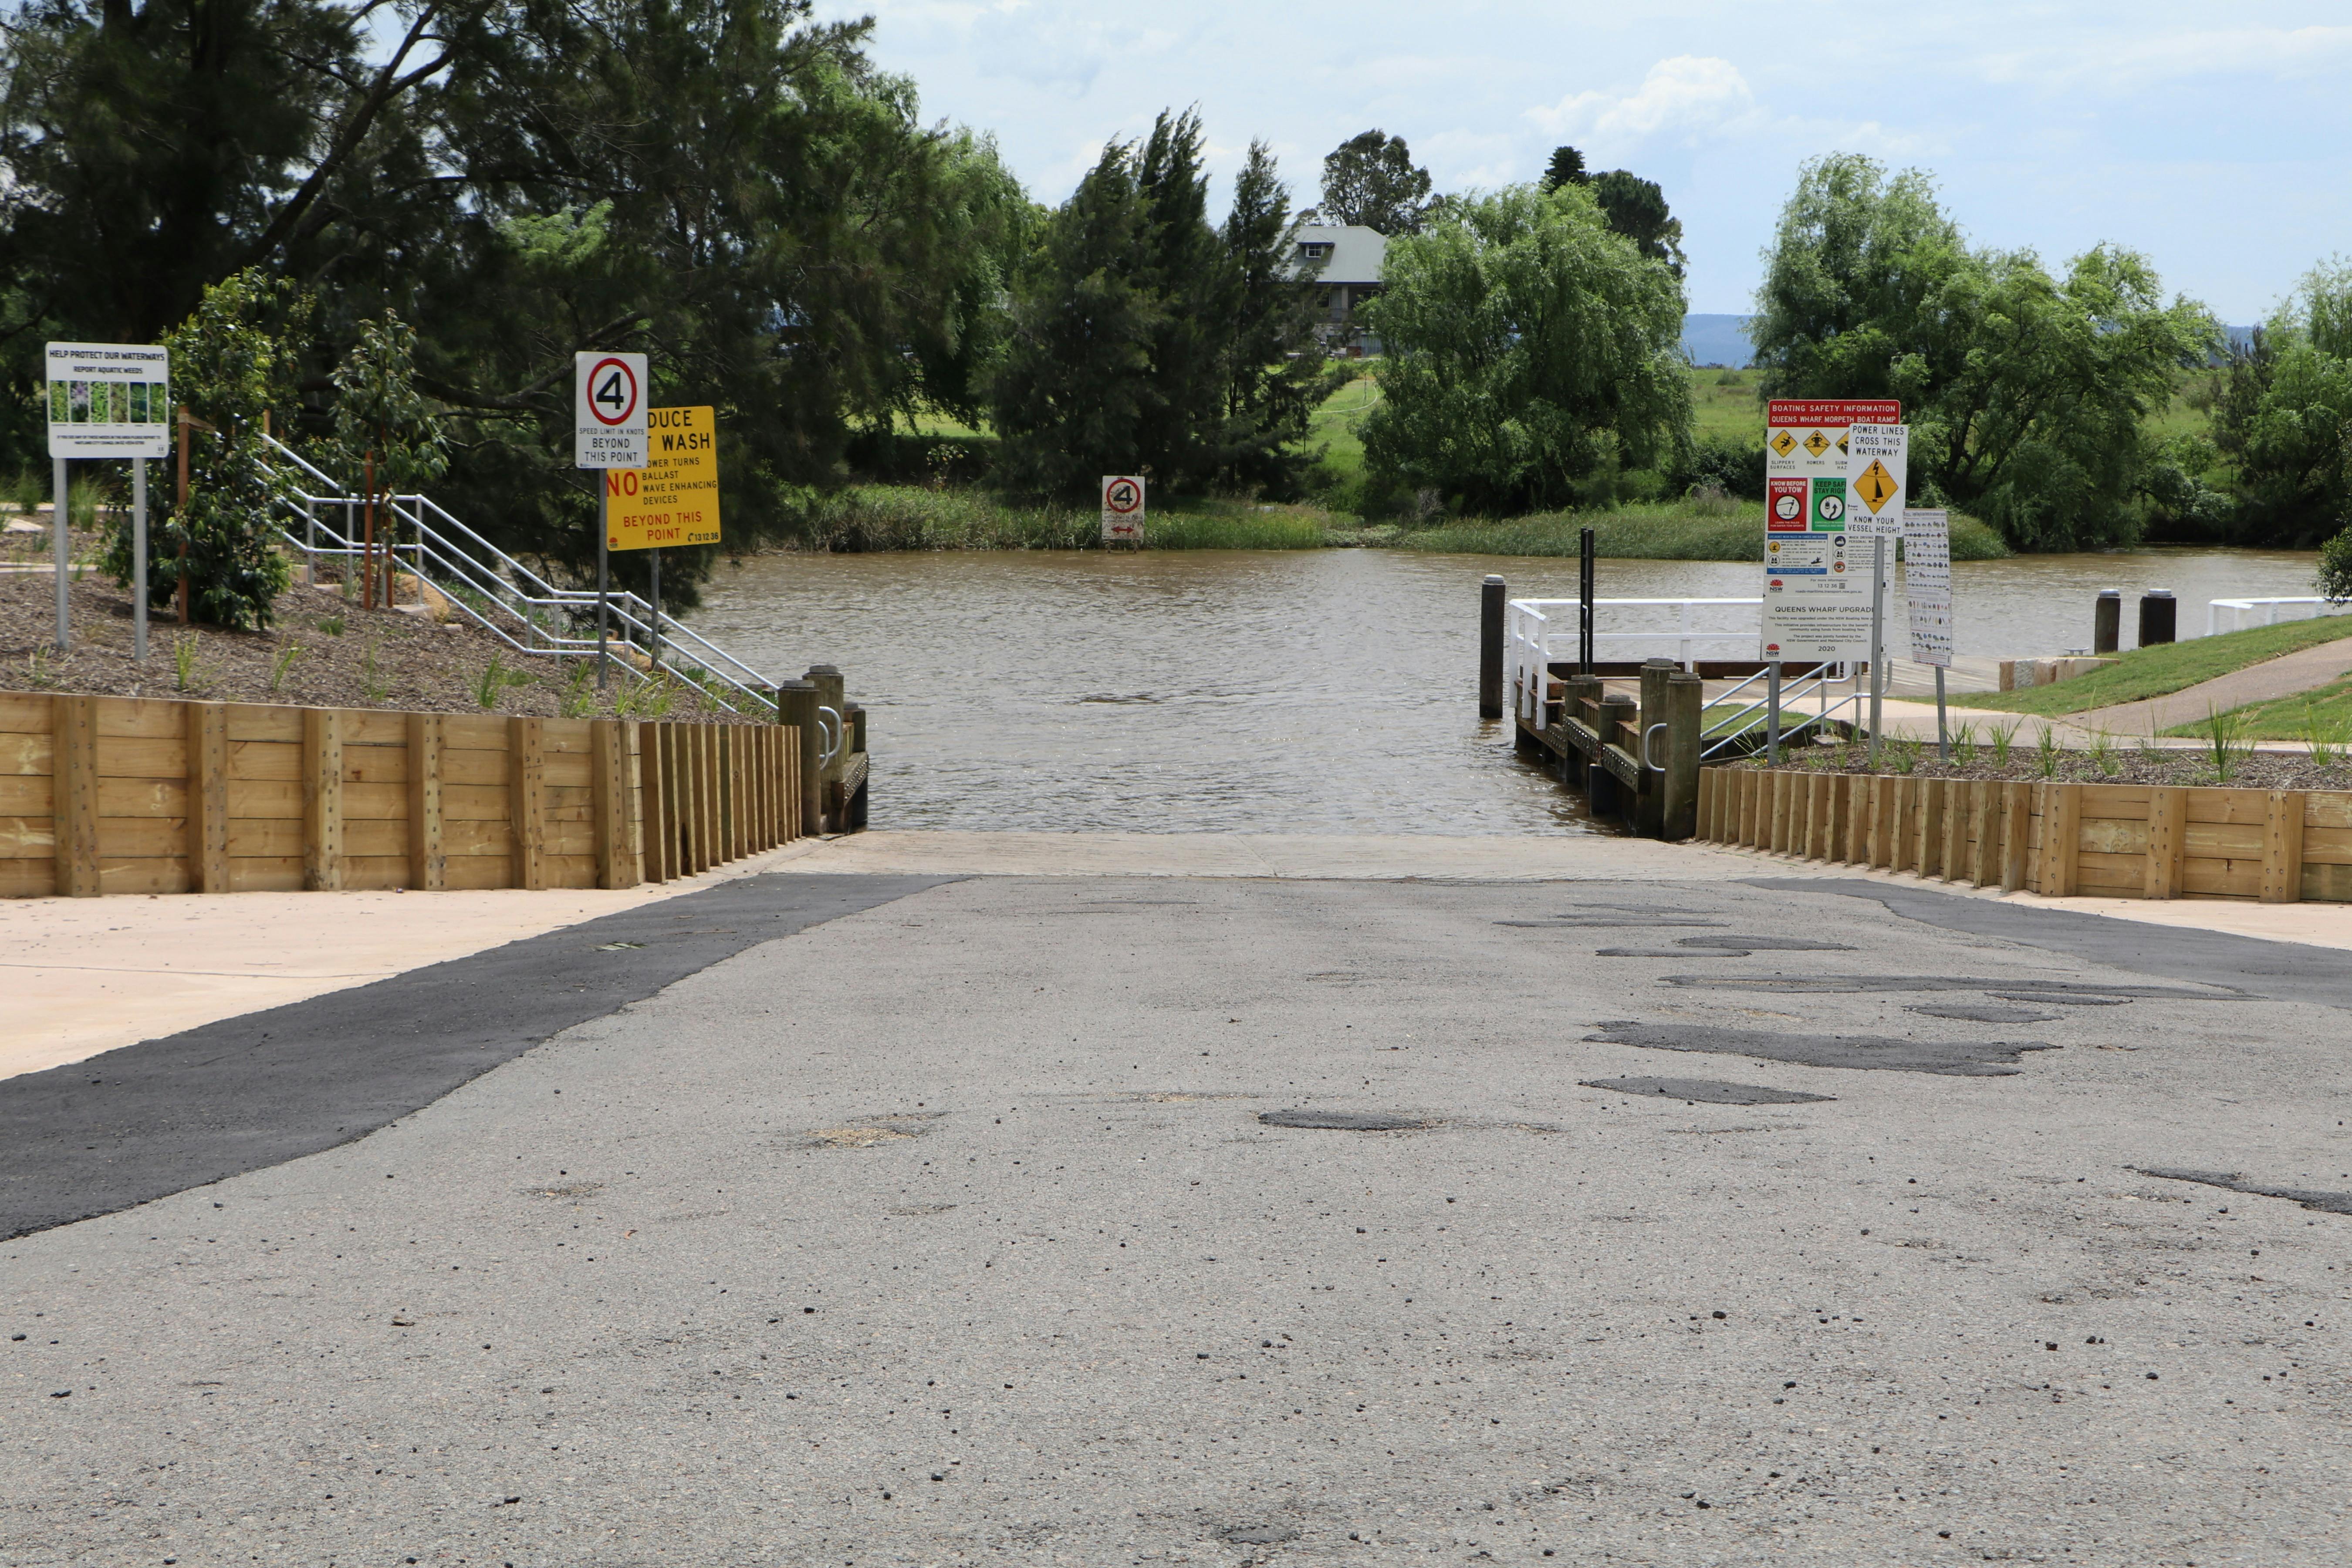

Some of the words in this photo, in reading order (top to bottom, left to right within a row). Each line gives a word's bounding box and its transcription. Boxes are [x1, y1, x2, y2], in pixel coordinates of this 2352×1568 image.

[70, 350, 103, 359] PROTECT
[121, 352, 165, 361] WATERWAYS
[596, 372, 624, 409] 4
[648, 410, 692, 429] DUCE
[1853, 426, 1878, 434] POWER
[1882, 427, 1904, 435] LINES
[592, 438, 630, 448] BEYOND
[662, 432, 710, 451] WASH
[1855, 437, 1879, 445] CROSS
[1883, 438, 1900, 446] THIS
[585, 452, 606, 462] THIS
[611, 452, 637, 462] POINT
[1856, 448, 1899, 457] WATERWAY
[647, 459, 670, 468] OWER
[673, 457, 700, 466] TURNS
[642, 471, 679, 480] BALLAST
[607, 471, 638, 497] NO
[643, 483, 666, 493] WAVE
[670, 480, 717, 491] ENHANCING
[643, 495, 678, 505] DEVICES
[1114, 486, 1132, 505] 4
[624, 514, 670, 527] BEYOND
[676, 511, 702, 524] THIS
[647, 528, 680, 541] POINT
